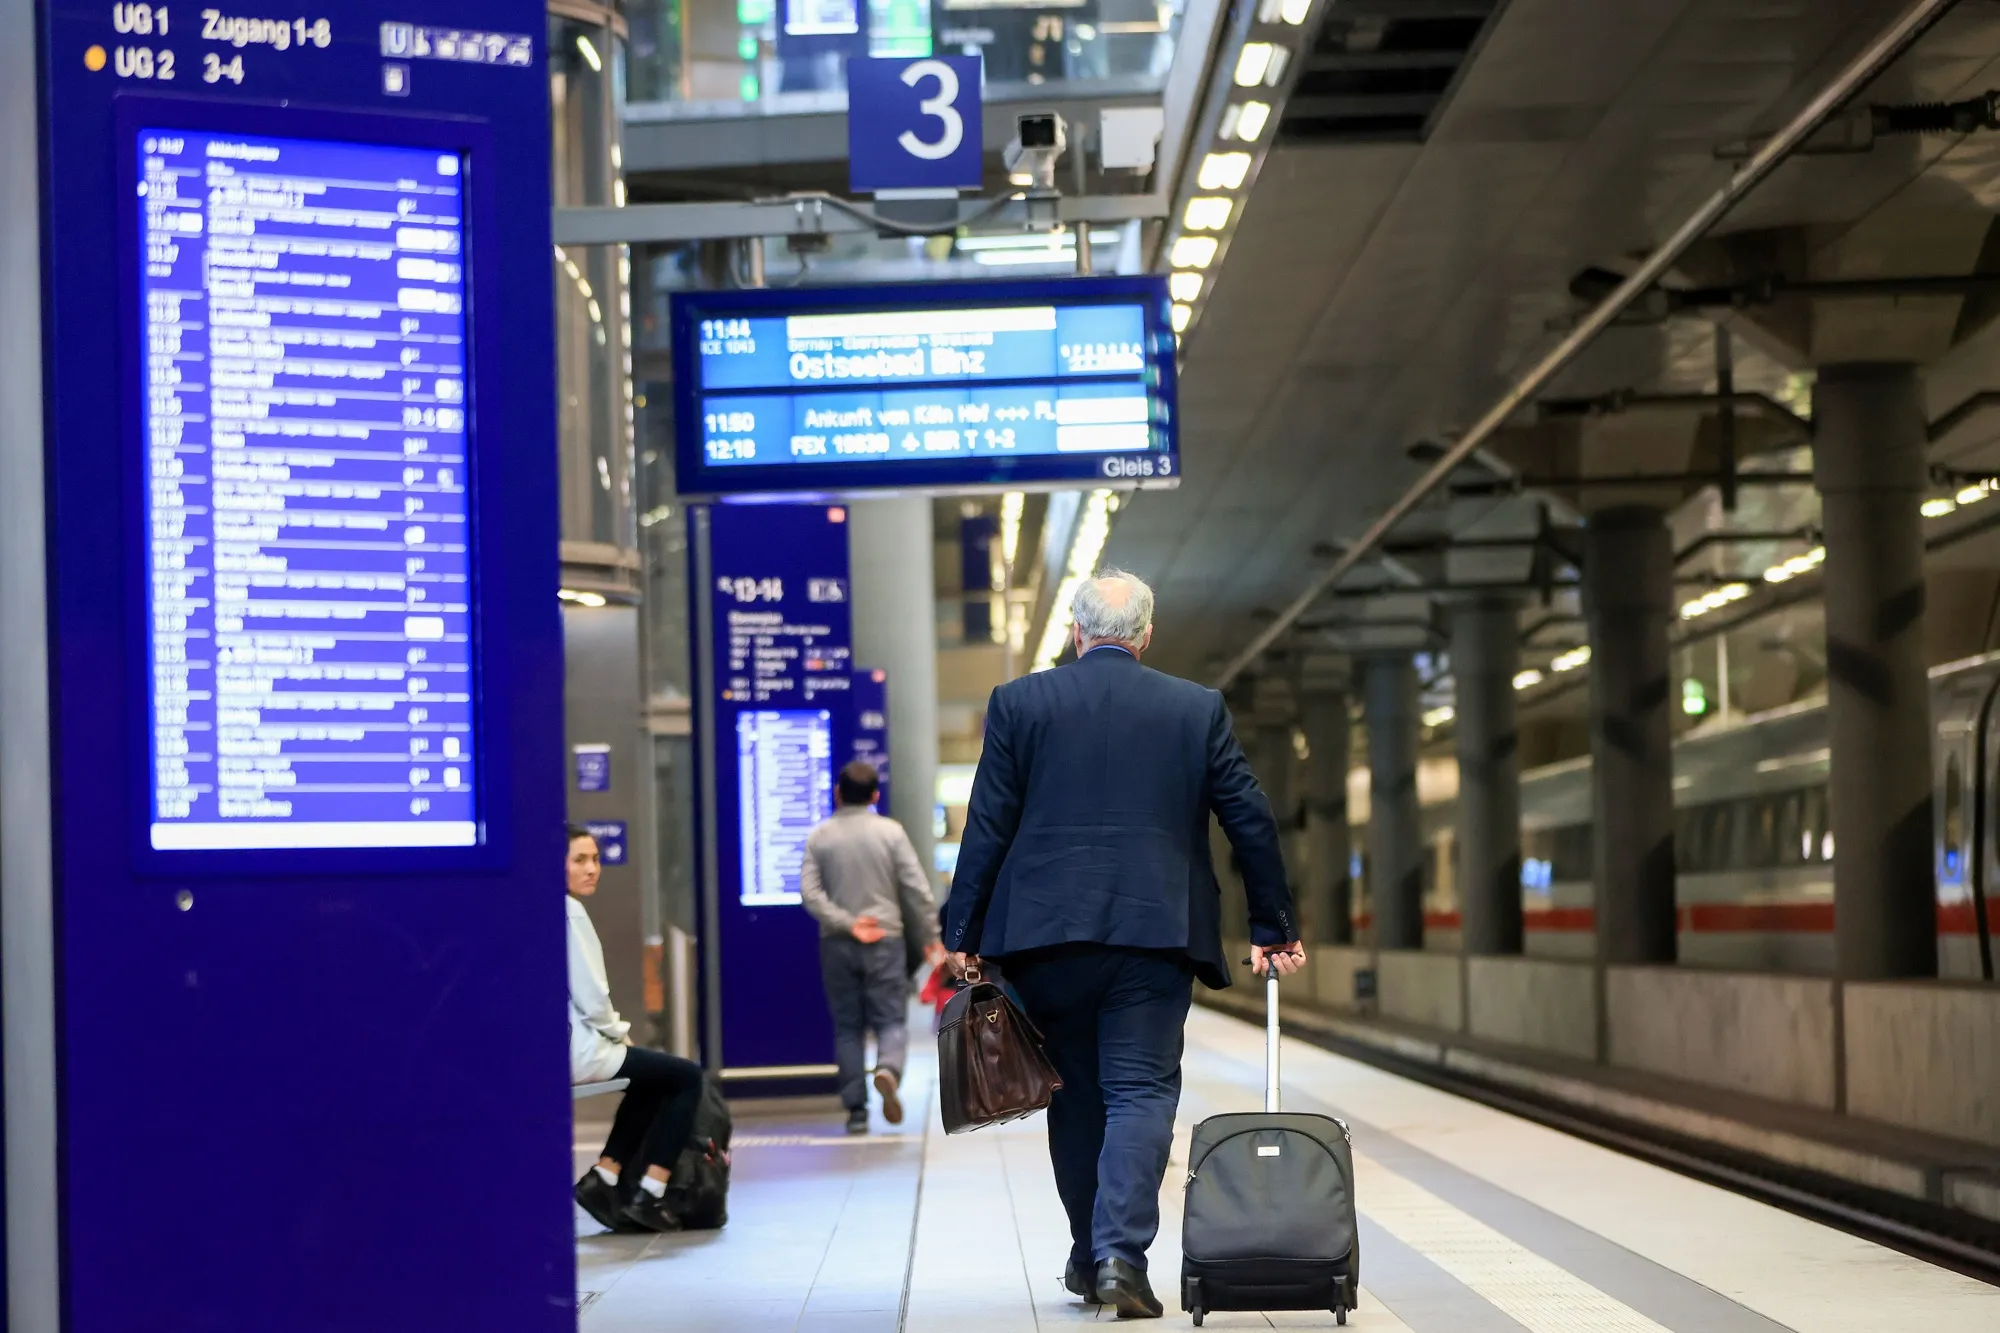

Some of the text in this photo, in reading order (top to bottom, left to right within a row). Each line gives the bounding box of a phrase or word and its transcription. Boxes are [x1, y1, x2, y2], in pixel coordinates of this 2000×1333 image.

[201, 8, 290, 51] Zugang
[203, 52, 244, 85] 3-4
[899, 60, 963, 159] 3
[1103, 454, 1172, 478] Gleis 3
